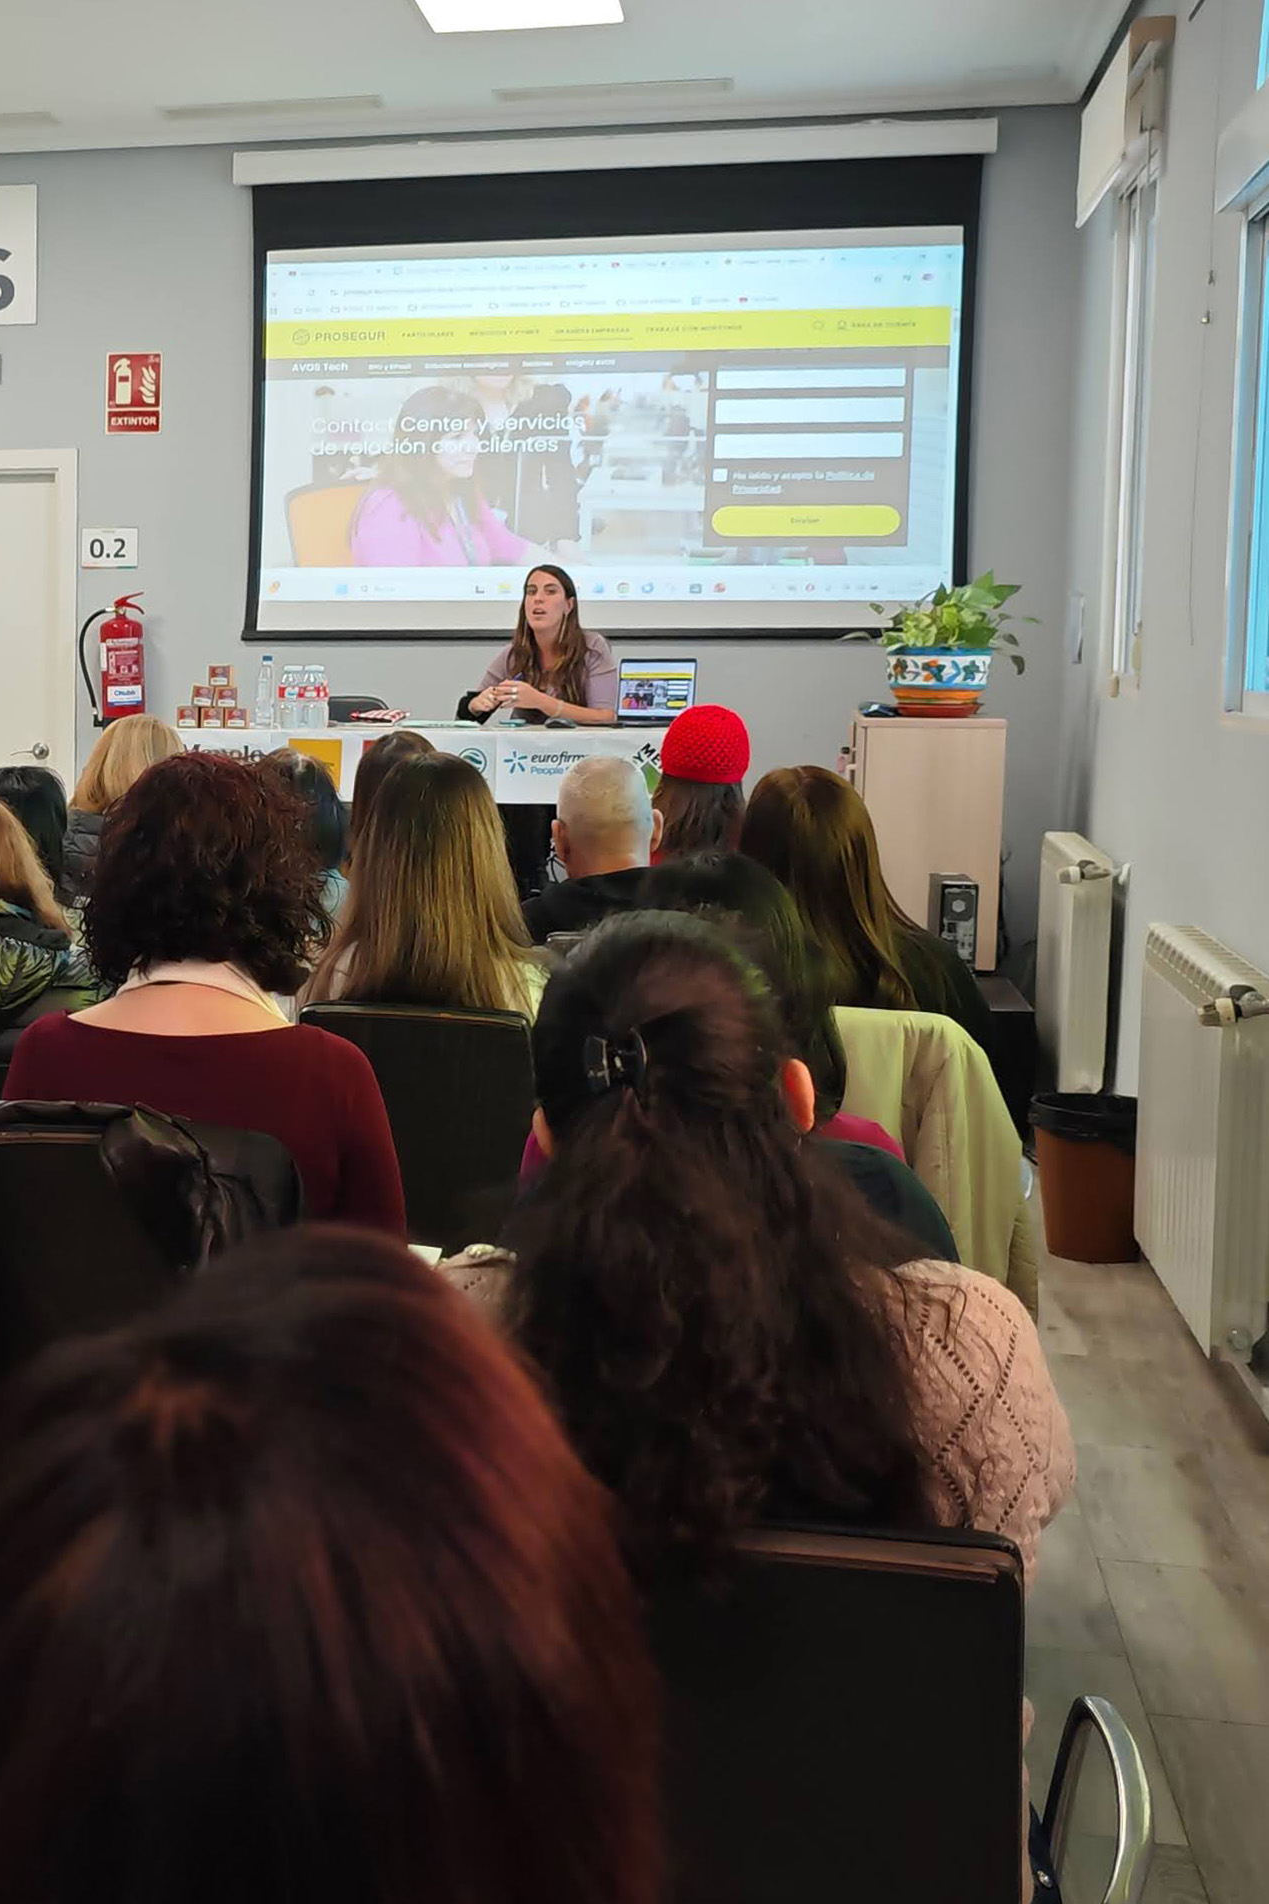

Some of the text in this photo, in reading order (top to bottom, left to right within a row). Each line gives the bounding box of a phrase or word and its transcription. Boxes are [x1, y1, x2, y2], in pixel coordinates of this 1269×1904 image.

[315, 331, 386, 342] PROSEGUR
[292, 361, 349, 373] AVOS Tech
[111, 416, 157, 426] EXTINTOR
[310, 412, 586, 435] Contact Center y servicios
[310, 436, 559, 456] de relación con clientes
[90, 538, 126, 558] 0.2
[531, 751, 588, 766] eurofirm
[530, 765, 564, 776] People
